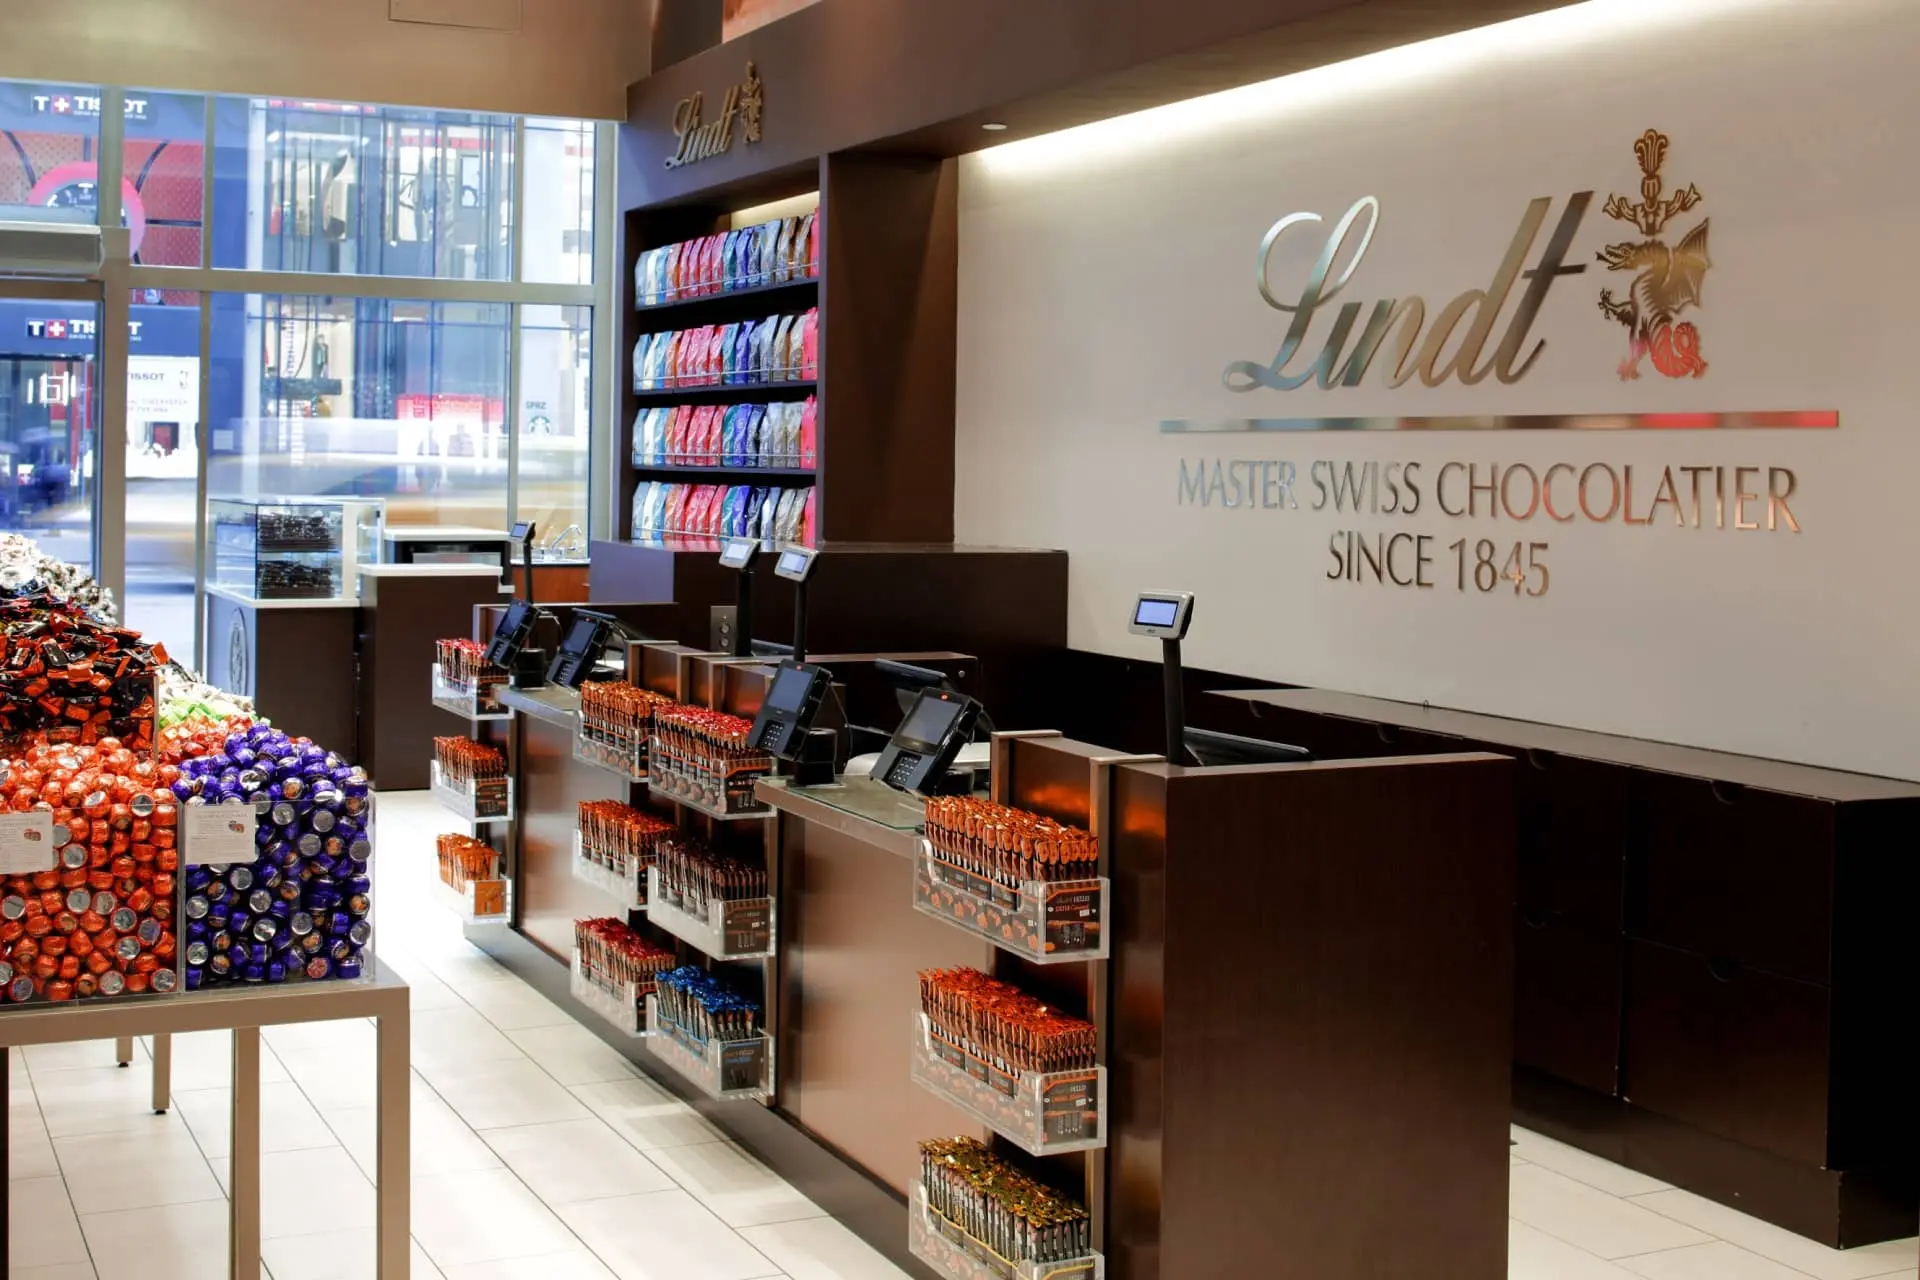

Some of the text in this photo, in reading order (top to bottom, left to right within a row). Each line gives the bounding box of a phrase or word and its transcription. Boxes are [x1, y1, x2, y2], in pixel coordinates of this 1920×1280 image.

[664, 85, 739, 169] Lindt
[1222, 190, 1595, 392] Lindt
[128, 372, 165, 381] ISSOT
[1177, 457, 1801, 534] MASTER SWISS CHOCOLATIER
[1326, 530, 1550, 597] SINCE 1845
